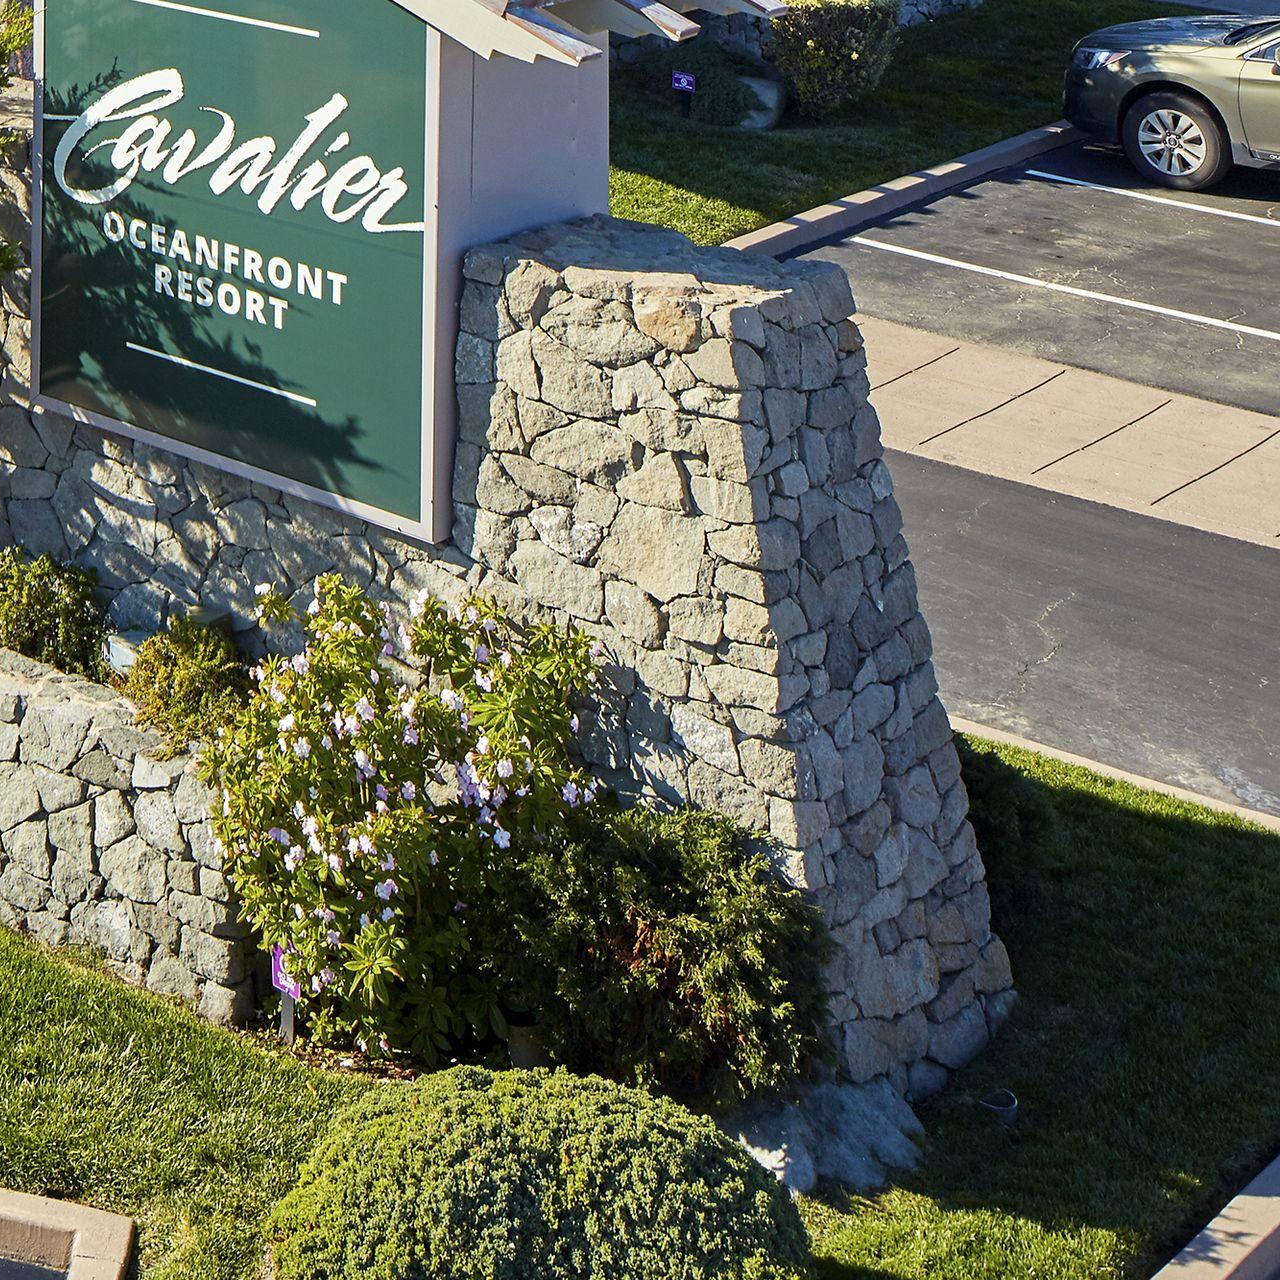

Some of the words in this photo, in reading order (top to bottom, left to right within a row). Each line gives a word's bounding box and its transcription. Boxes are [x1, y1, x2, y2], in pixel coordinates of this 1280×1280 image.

[43, 67, 425, 233] Cavalier
[102, 210, 348, 306] OCEANFRONT
[154, 262, 289, 330] RESORT
